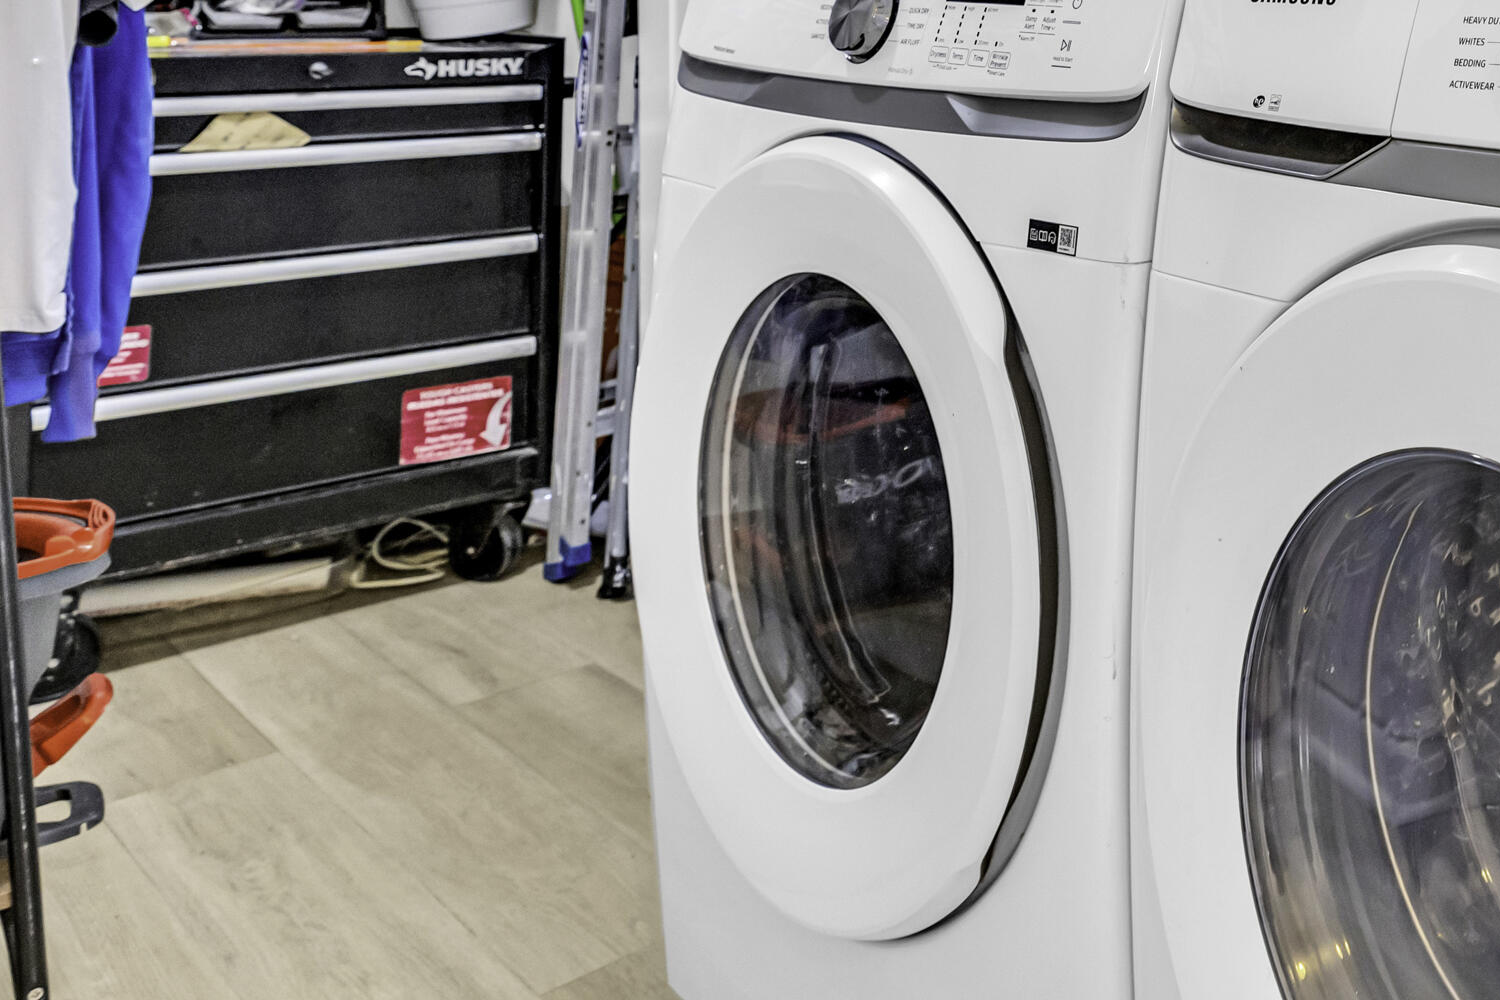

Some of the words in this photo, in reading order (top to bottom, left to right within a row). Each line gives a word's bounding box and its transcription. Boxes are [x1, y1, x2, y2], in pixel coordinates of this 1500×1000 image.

[1463, 16, 1487, 24] HEAVY
[1458, 38, 1486, 46] WHITES
[437, 57, 524, 78] HUSKY
[1453, 58, 1486, 68] BEDDING
[1449, 80, 1495, 91] ACTIVEWEAR
